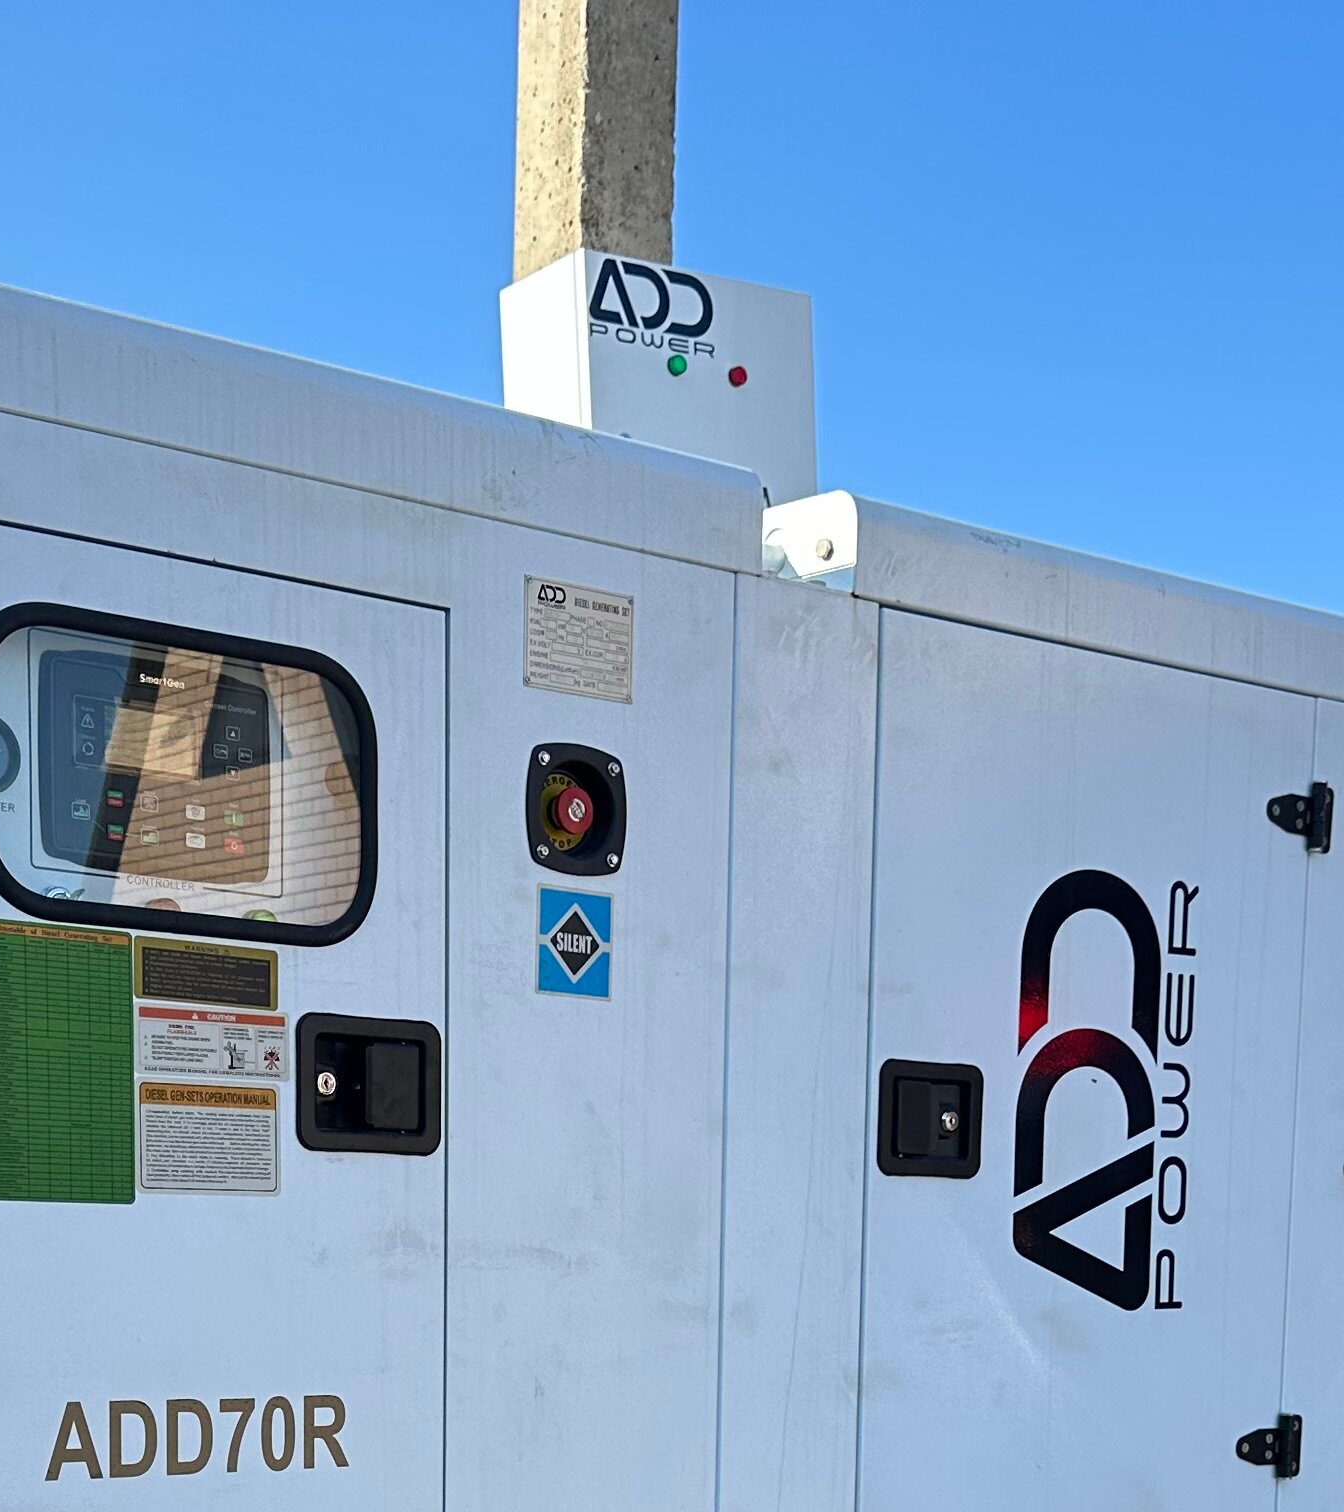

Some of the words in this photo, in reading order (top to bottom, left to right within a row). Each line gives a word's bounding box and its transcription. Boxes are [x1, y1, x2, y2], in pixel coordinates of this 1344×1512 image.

[589, 258, 714, 338] ADD
[589, 322, 716, 359] POWER
[139, 673, 185, 690] SmartGen
[126, 875, 196, 892] CONTROLLER
[556, 931, 593, 955] SILENT
[145, 1088, 170, 1101] DIESEL
[170, 1089, 205, 1104] GEN-SETS
[204, 1091, 243, 1105] OPERATION
[243, 1093, 272, 1106] MANUAL
[1012, 869, 1162, 1312] ADD
[1154, 880, 1200, 1310] POWER
[44, 1394, 350, 1482] ADD70R
